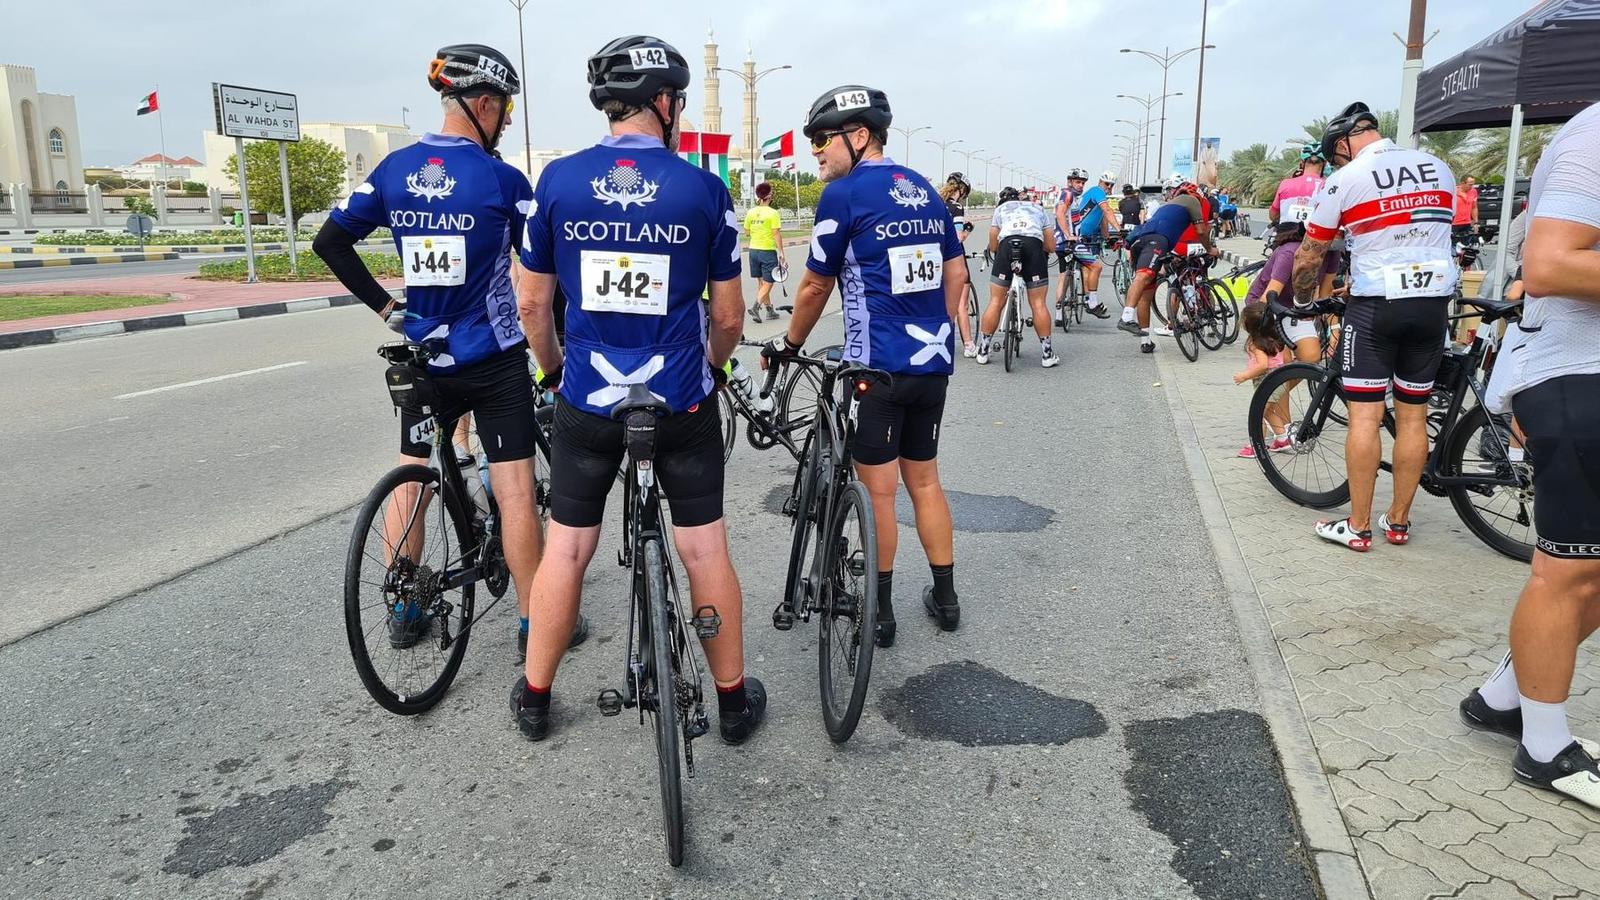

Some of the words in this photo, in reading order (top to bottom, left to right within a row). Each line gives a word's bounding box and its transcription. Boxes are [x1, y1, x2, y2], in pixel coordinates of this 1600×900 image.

[479, 58, 507, 82] J-44
[633, 50, 665, 67] J-42
[1441, 63, 1481, 100] STEALTH
[840, 92, 866, 107] J-43
[227, 113, 240, 123] AL
[245, 115, 279, 127] WAHDA
[283, 120, 294, 128] ST
[1371, 162, 1439, 190] UAE
[1379, 193, 1441, 213] Emirates
[390, 210, 475, 231] SCOTLAND
[563, 220, 690, 244] SCOTLAND
[412, 251, 451, 274] J-44
[905, 259, 934, 284] J-43
[596, 269, 650, 299] J-42
[1400, 271, 1434, 290] L-37
[1342, 324, 1354, 372] Sunweb
[416, 418, 436, 441] J-44
[1539, 540, 1560, 552] COL
